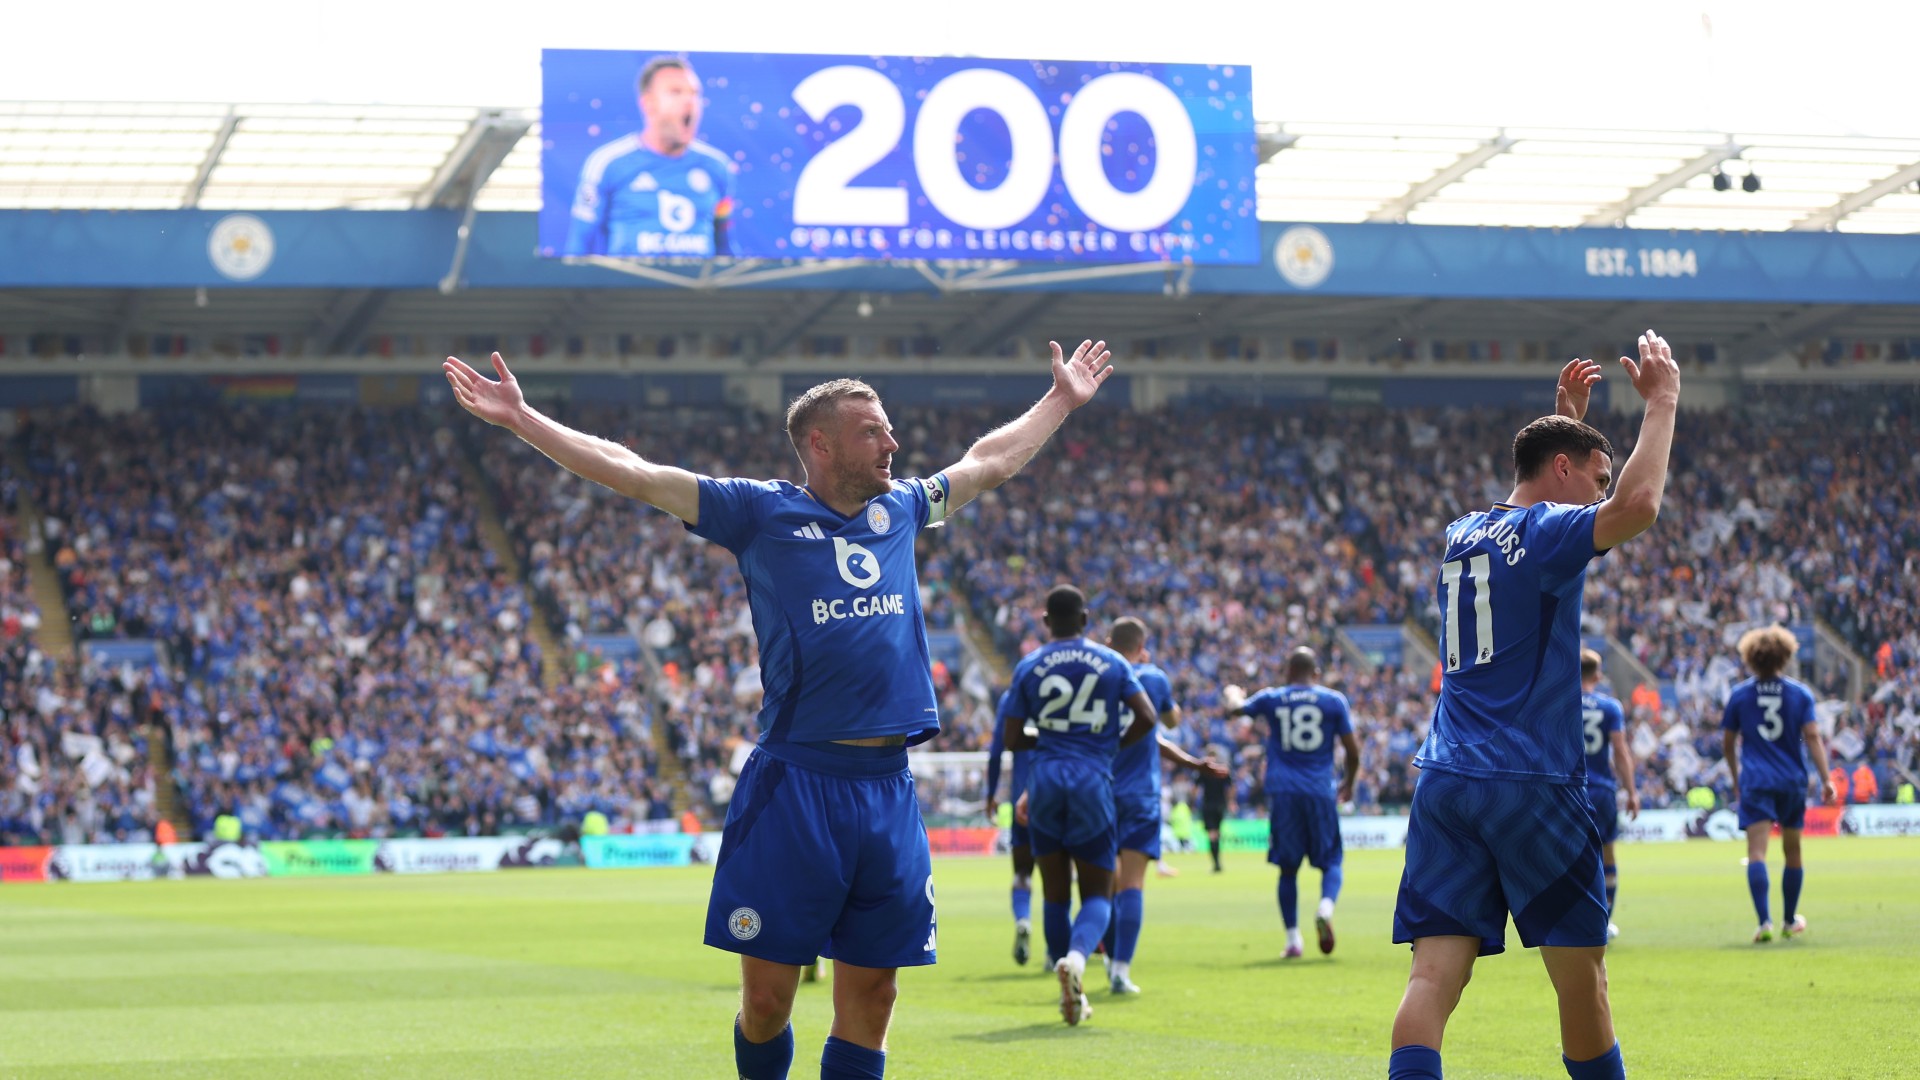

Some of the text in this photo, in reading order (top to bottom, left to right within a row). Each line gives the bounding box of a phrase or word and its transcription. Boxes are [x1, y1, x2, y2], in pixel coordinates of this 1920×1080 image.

[792, 65, 1197, 232] 200
[898, 228, 952, 249] FOR
[965, 230, 1117, 251] LEICESTER
[1585, 247, 1698, 277] EST. 1884
[811, 594, 905, 625] BC.GAME
[1441, 553, 1494, 673] 11
[1038, 673, 1108, 734] 24
[1757, 695, 1784, 742] 3
[1275, 704, 1324, 752] 18
